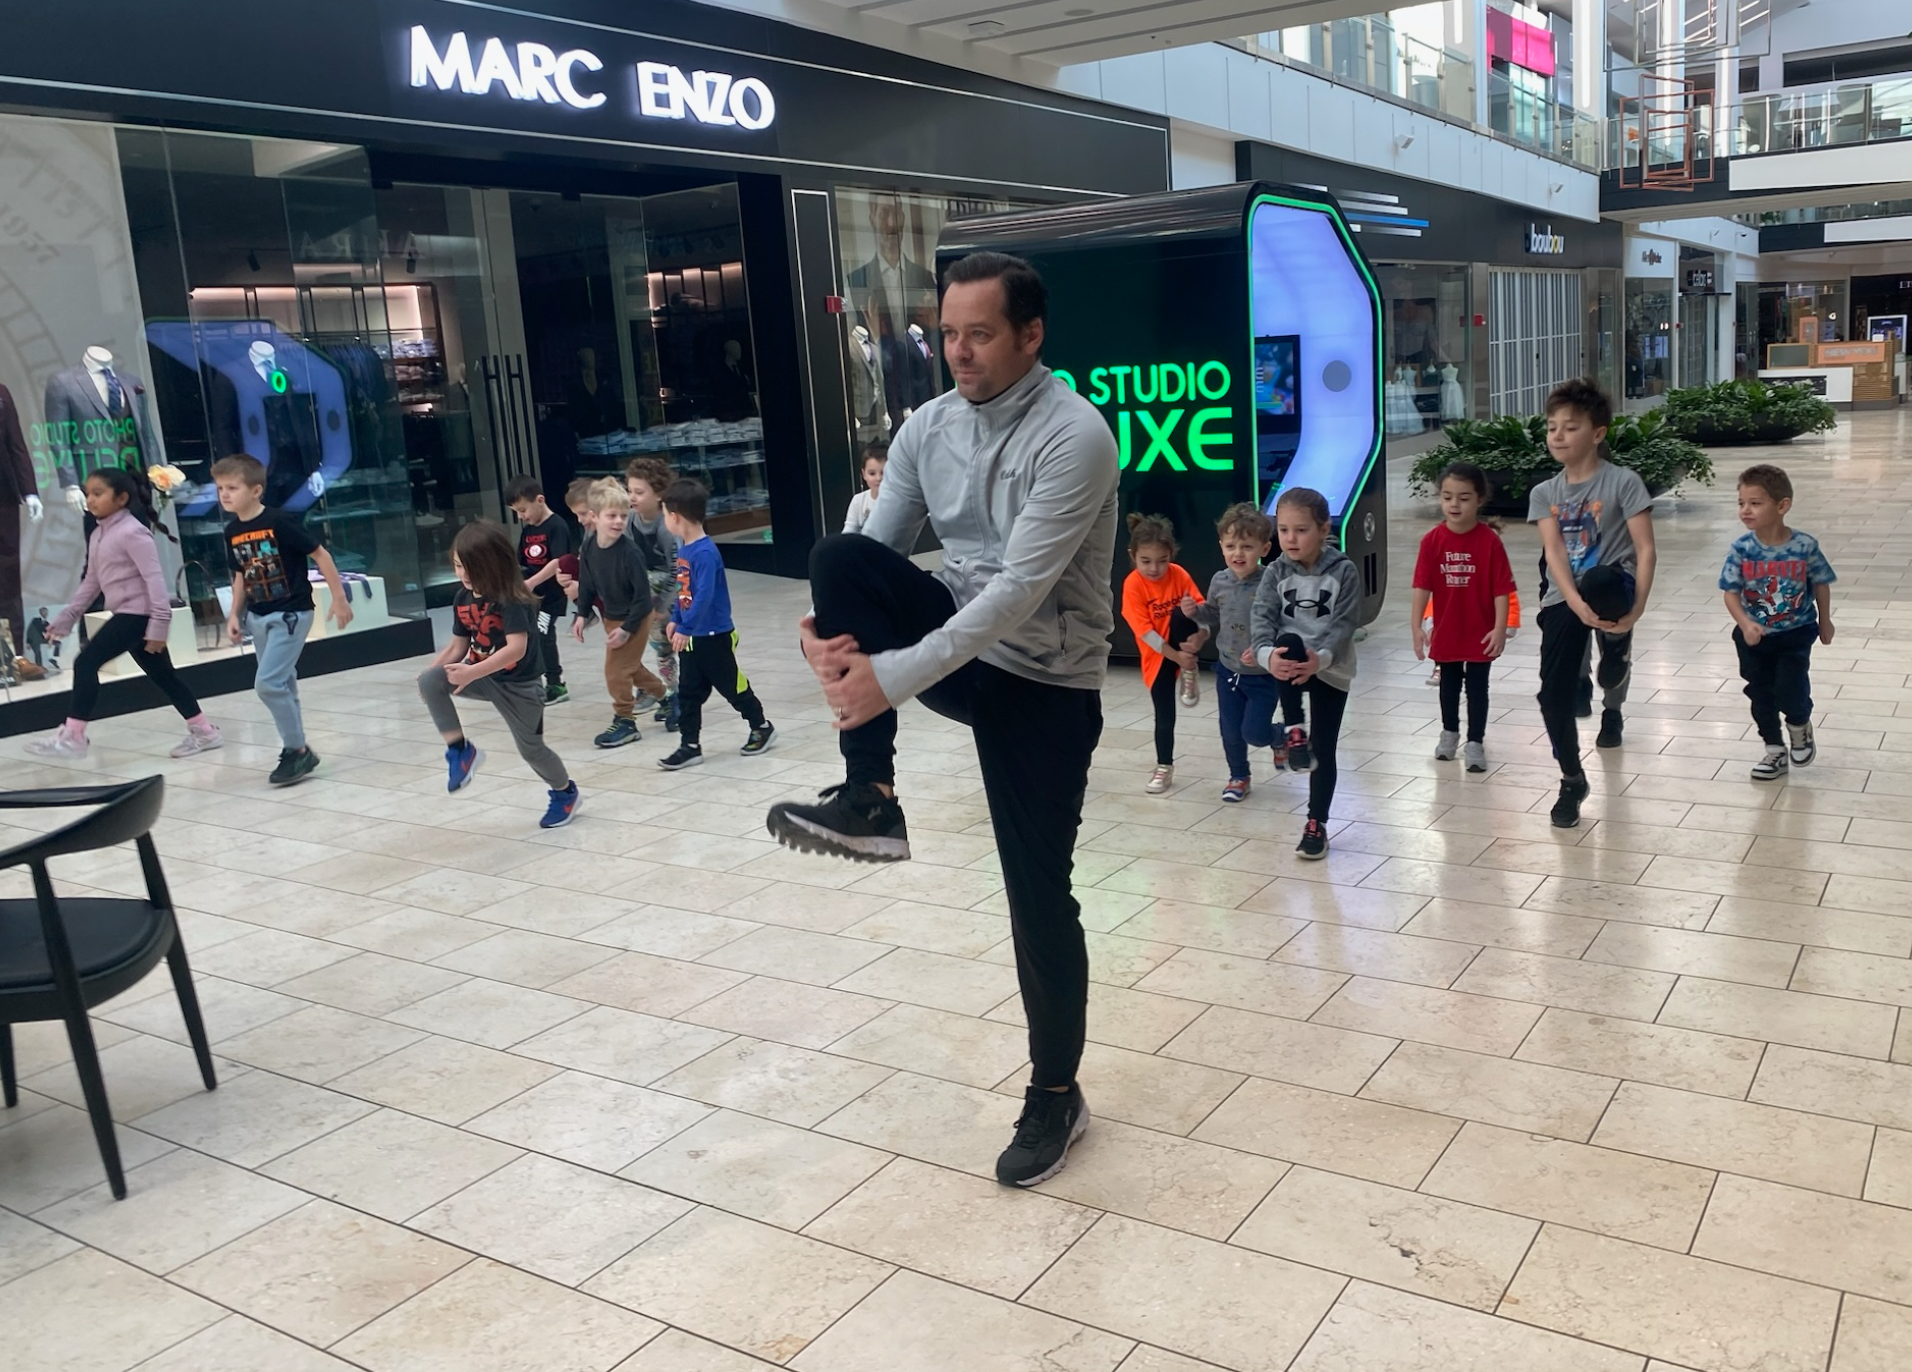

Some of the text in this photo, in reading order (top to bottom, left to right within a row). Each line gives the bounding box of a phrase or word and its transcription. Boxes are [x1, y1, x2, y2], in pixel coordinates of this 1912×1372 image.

[410, 24, 776, 131] MARC ENZO
[1089, 360, 1232, 405] STUDIO
[1444, 551, 1472, 562] Future
[1742, 560, 1807, 582] MARVEL
[537, 610, 552, 635] NIKE
